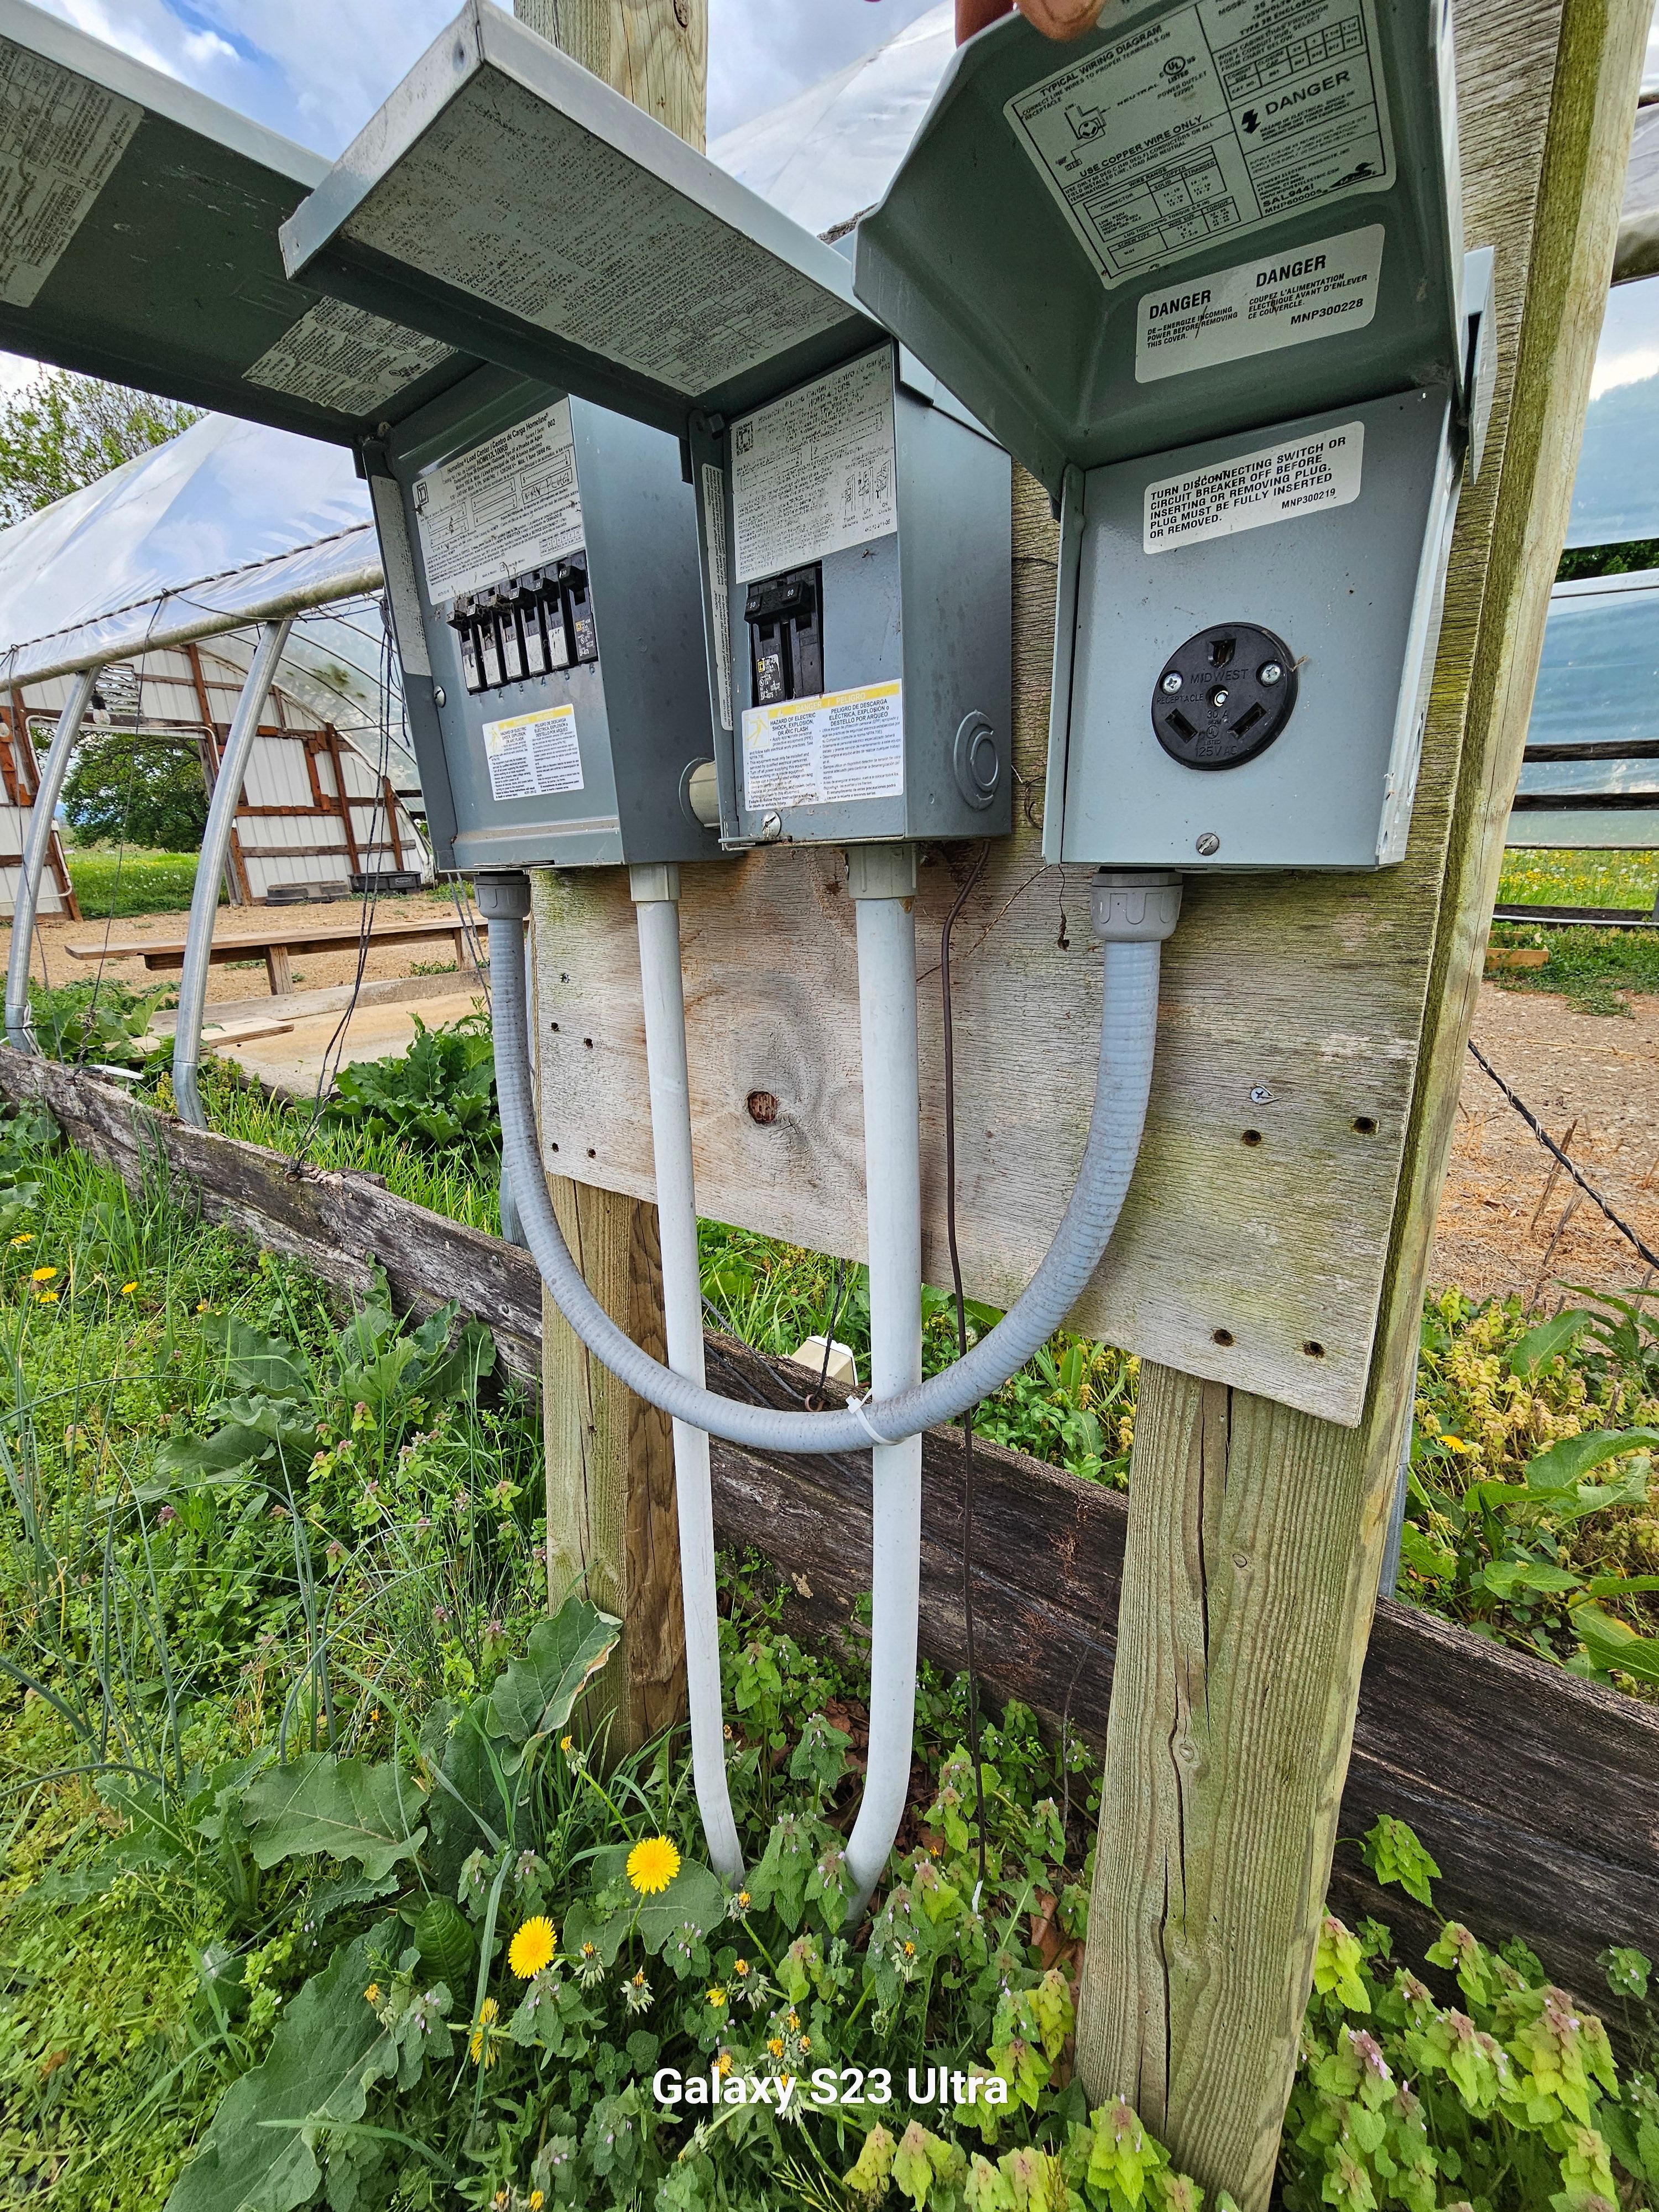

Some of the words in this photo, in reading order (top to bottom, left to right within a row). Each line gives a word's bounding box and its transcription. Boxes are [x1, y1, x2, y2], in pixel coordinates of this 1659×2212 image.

[1039, 71, 1079, 97] TYPICAL
[1078, 50, 1115, 75] WIRING
[1114, 24, 1163, 55] DIAGRAM
[1265, 69, 1350, 114] DANGER
[1023, 96, 1063, 120] RECEPTACLE
[1079, 163, 1100, 178] USE
[1100, 143, 1143, 167] COPPER
[1144, 130, 1171, 147] WIRE
[1172, 114, 1203, 134] ONLY
[1256, 253, 1327, 288] DANGER
[1249, 291, 1277, 305] COUPEZ
[1280, 273, 1344, 296] L'ALIMENTATION
[1249, 294, 1293, 312] ELECTRIQUE
[1295, 286, 1321, 299] AVANT
[1323, 274, 1367, 292] D'ENLEVER
[1149, 289, 1212, 320] DANGER
[1197, 306, 1232, 321] INCOMING
[1259, 299, 1305, 316] COUVERCLE.
[1290, 298, 1363, 325] MNP300228
[1147, 329, 1171, 341] POWER
[1173, 322, 1198, 335] BEFORE
[1201, 311, 1238, 327] REMOVING
[1147, 339, 1162, 348] THIS
[1164, 332, 1187, 344] COVER.
[466, 452, 476, 463] Load
[1151, 485, 1178, 500] TURN
[1183, 458, 1272, 492] DISCONNECTING
[1277, 442, 1323, 464] SWITCH
[1328, 436, 1345, 449] OR
[1151, 492, 1191, 510] CIRCUIT
[1196, 476, 1245, 498] BREAKER
[1250, 468, 1271, 482] OFF
[1276, 453, 1322, 474] BEFORE
[1151, 497, 1206, 519] INSERTING
[1210, 492, 1224, 503] OR
[1229, 473, 1290, 498] REMOVING
[1295, 462, 1331, 480] PLUG.
[1150, 515, 1176, 529] PLUG
[1181, 505, 1212, 521] MUST
[1215, 500, 1229, 512] BE
[1234, 489, 1269, 507] FULLY
[1274, 472, 1332, 495] INSERTED
[1281, 487, 1335, 509] MNP300219
[1150, 529, 1163, 539] OR
[1167, 513, 1222, 534] REMOVED.
[1191, 669, 1248, 684] MIDWEST
[797, 700, 822, 712] DANGER
[836, 691, 865, 704] PELIGRO
[831, 705, 851, 714] PELIGRO
[860, 698, 887, 708] DESCARGA
[1157, 694, 1203, 704] RECEPTACLE
[770, 717, 787, 726] HAZARD
[795, 712, 816, 721] ELECTRIC
[788, 718, 814, 728] EXPLOSION,
[829, 710, 856, 721] ELÉCTRICA,
[857, 705, 885, 716] EXPLOSIÓN
[831, 717, 854, 726] DESTELLO
[867, 711, 888, 720] ARQUEO
[1207, 710, 1218, 719] 30
